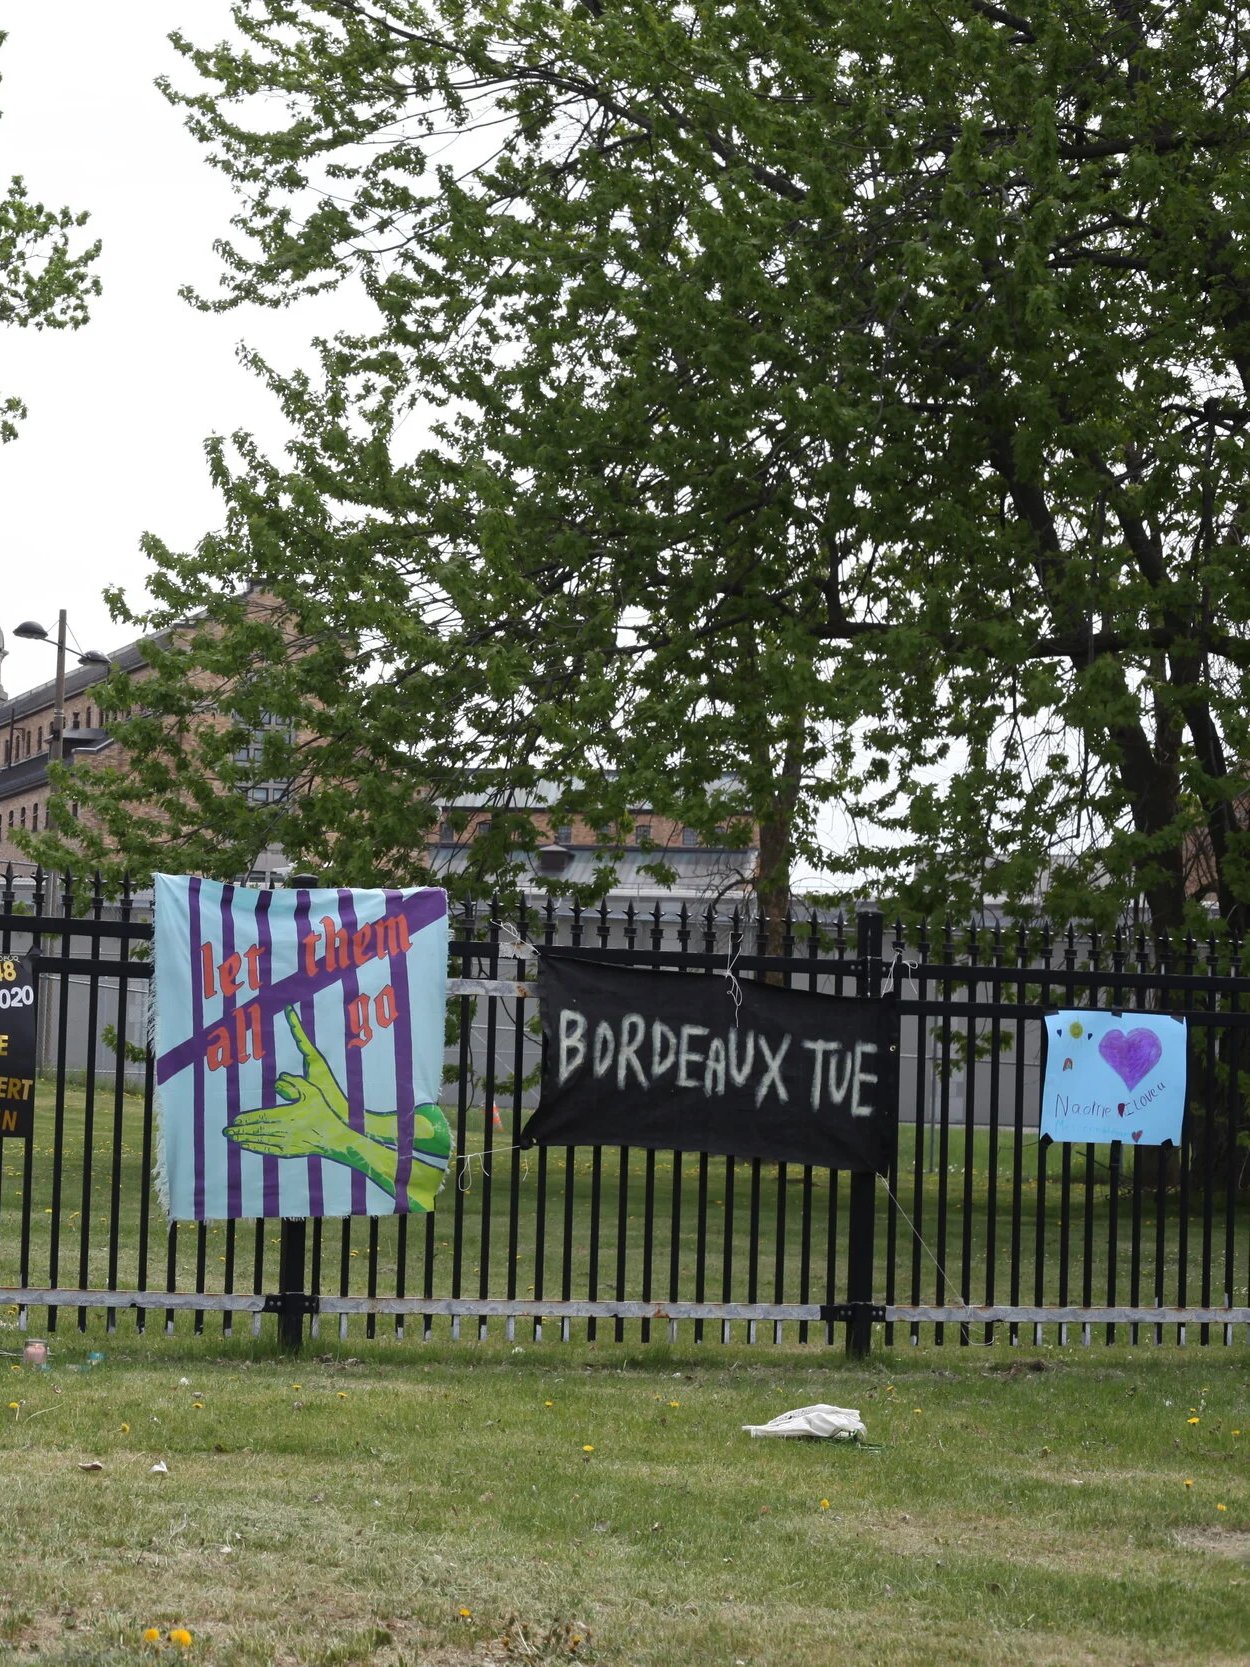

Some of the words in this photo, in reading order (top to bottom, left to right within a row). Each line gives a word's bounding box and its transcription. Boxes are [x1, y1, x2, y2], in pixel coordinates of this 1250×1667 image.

[200, 941, 265, 999] let
[303, 913, 413, 977] them
[206, 1003, 267, 1071] all
[348, 984, 399, 1049] go
[558, 1008, 792, 1109] BORDEAUX
[802, 1038, 878, 1117] TUE
